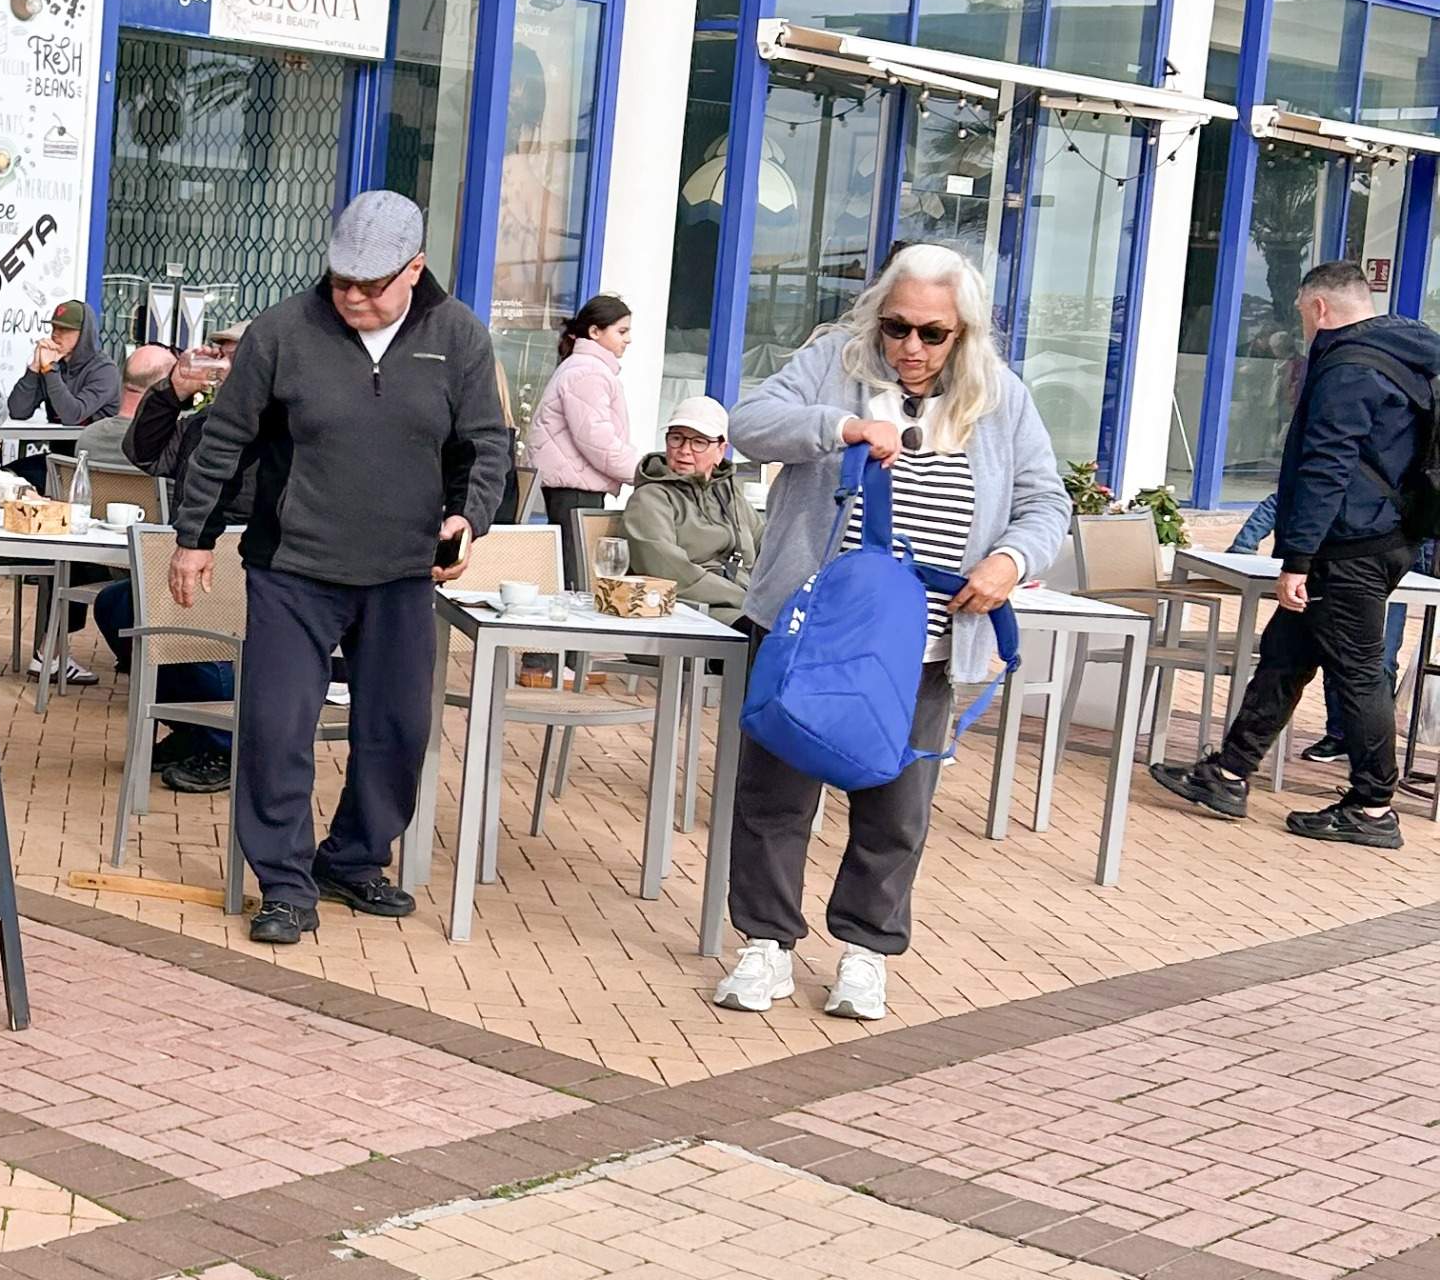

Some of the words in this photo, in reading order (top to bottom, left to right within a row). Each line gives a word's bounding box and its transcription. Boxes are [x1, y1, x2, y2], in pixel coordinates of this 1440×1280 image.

[251, 10, 272, 23] HAIR
[286, 14, 320, 29] BEAUTY
[35, 78, 75, 99] BEANS
[2, 308, 52, 334] BRUNC
